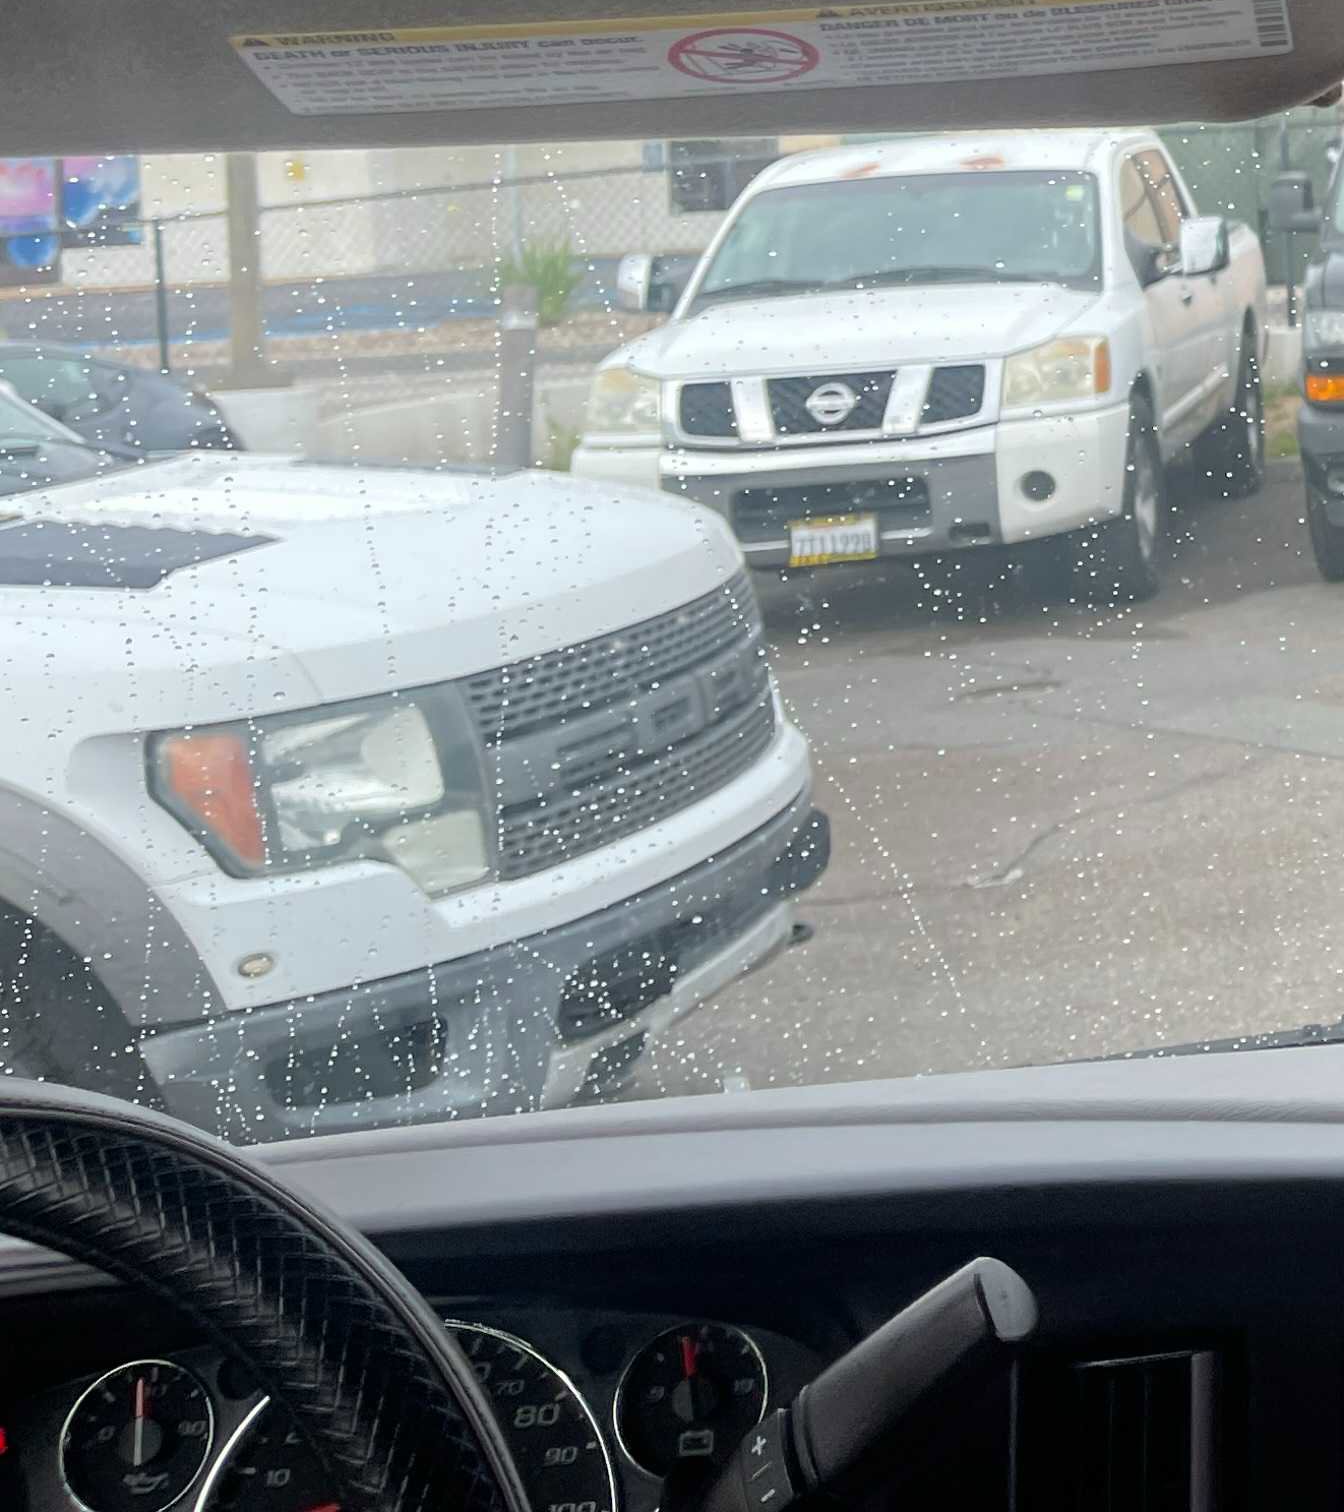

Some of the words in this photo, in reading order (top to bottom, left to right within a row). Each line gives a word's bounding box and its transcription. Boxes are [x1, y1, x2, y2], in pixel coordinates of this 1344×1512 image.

[820, 18, 900, 32] DANGER
[276, 31, 396, 47] WARNING
[253, 49, 325, 61] DEATH
[513, 1403, 561, 1428] 80
[543, 1446, 579, 1467] 90
[265, 1468, 291, 1487] 10
